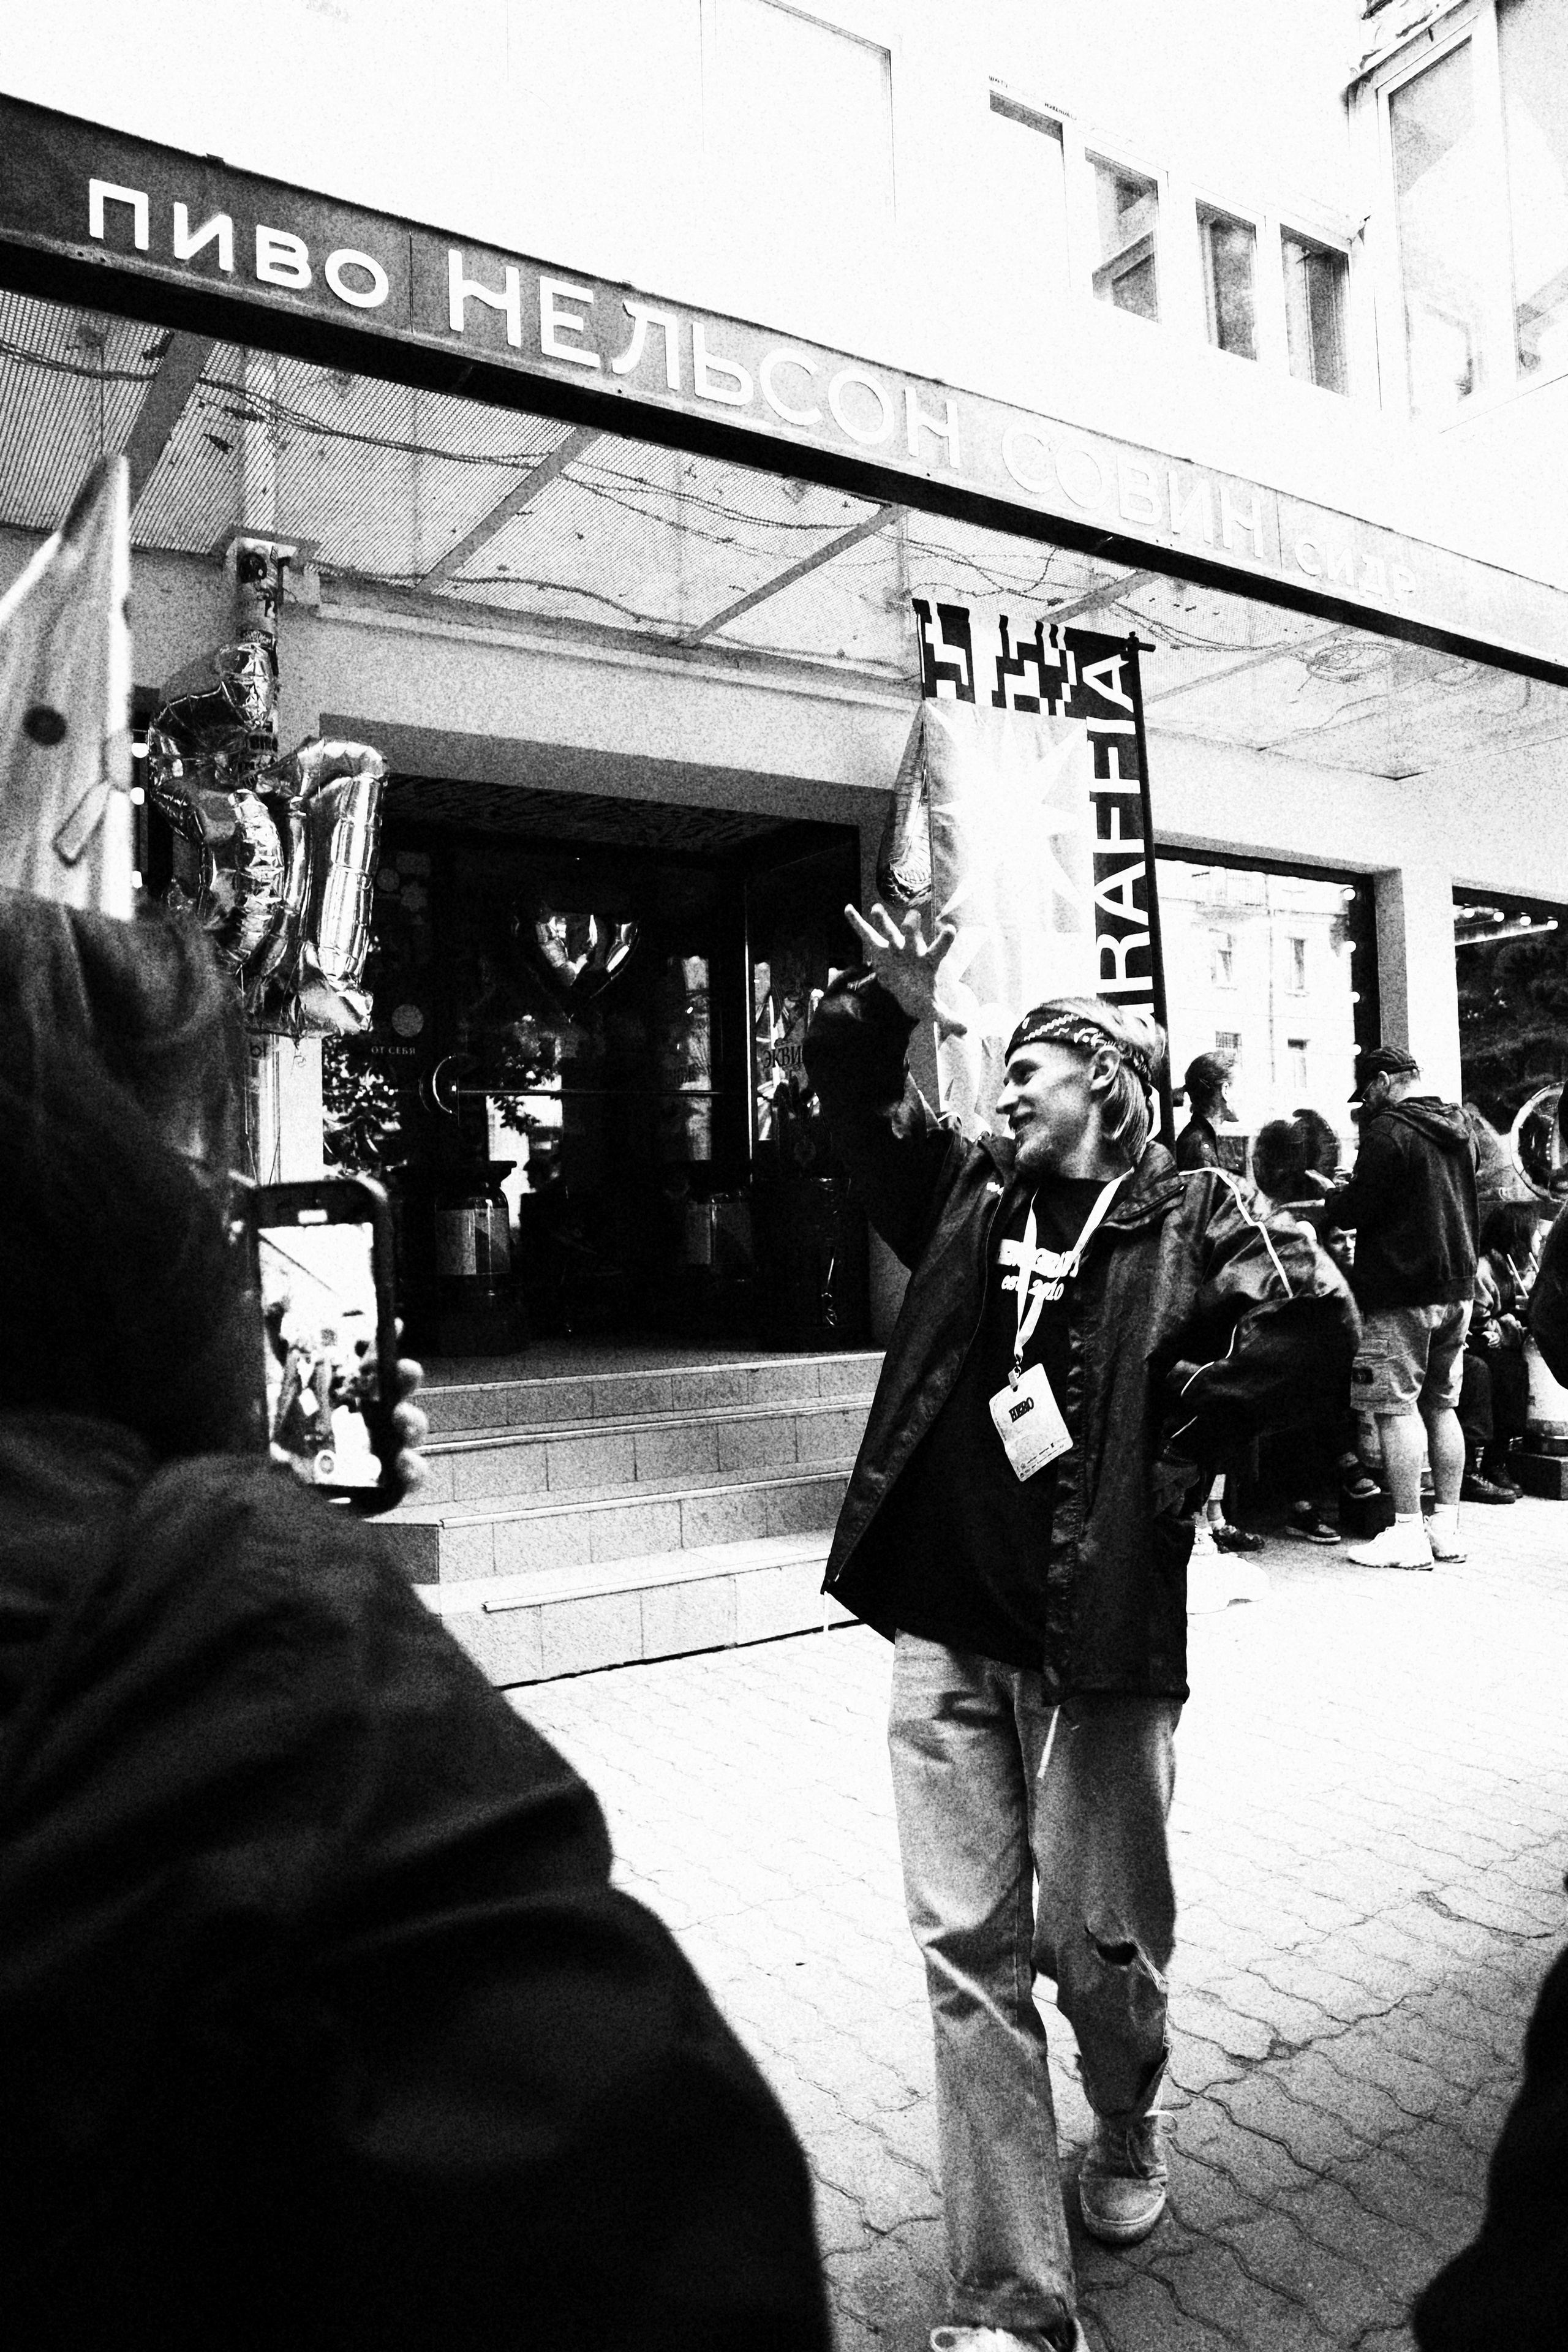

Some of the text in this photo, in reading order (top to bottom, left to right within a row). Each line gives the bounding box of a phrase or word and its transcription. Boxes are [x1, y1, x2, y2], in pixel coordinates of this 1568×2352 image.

[89, 178, 1418, 606] ПИВО НЕЛЬСОН СОВИН СИДР
[1082, 654, 1155, 1019] RAFFIA
[388, 1046, 415, 1055] СЕБЯ
[763, 1045, 801, 1068] ЭКВИ
